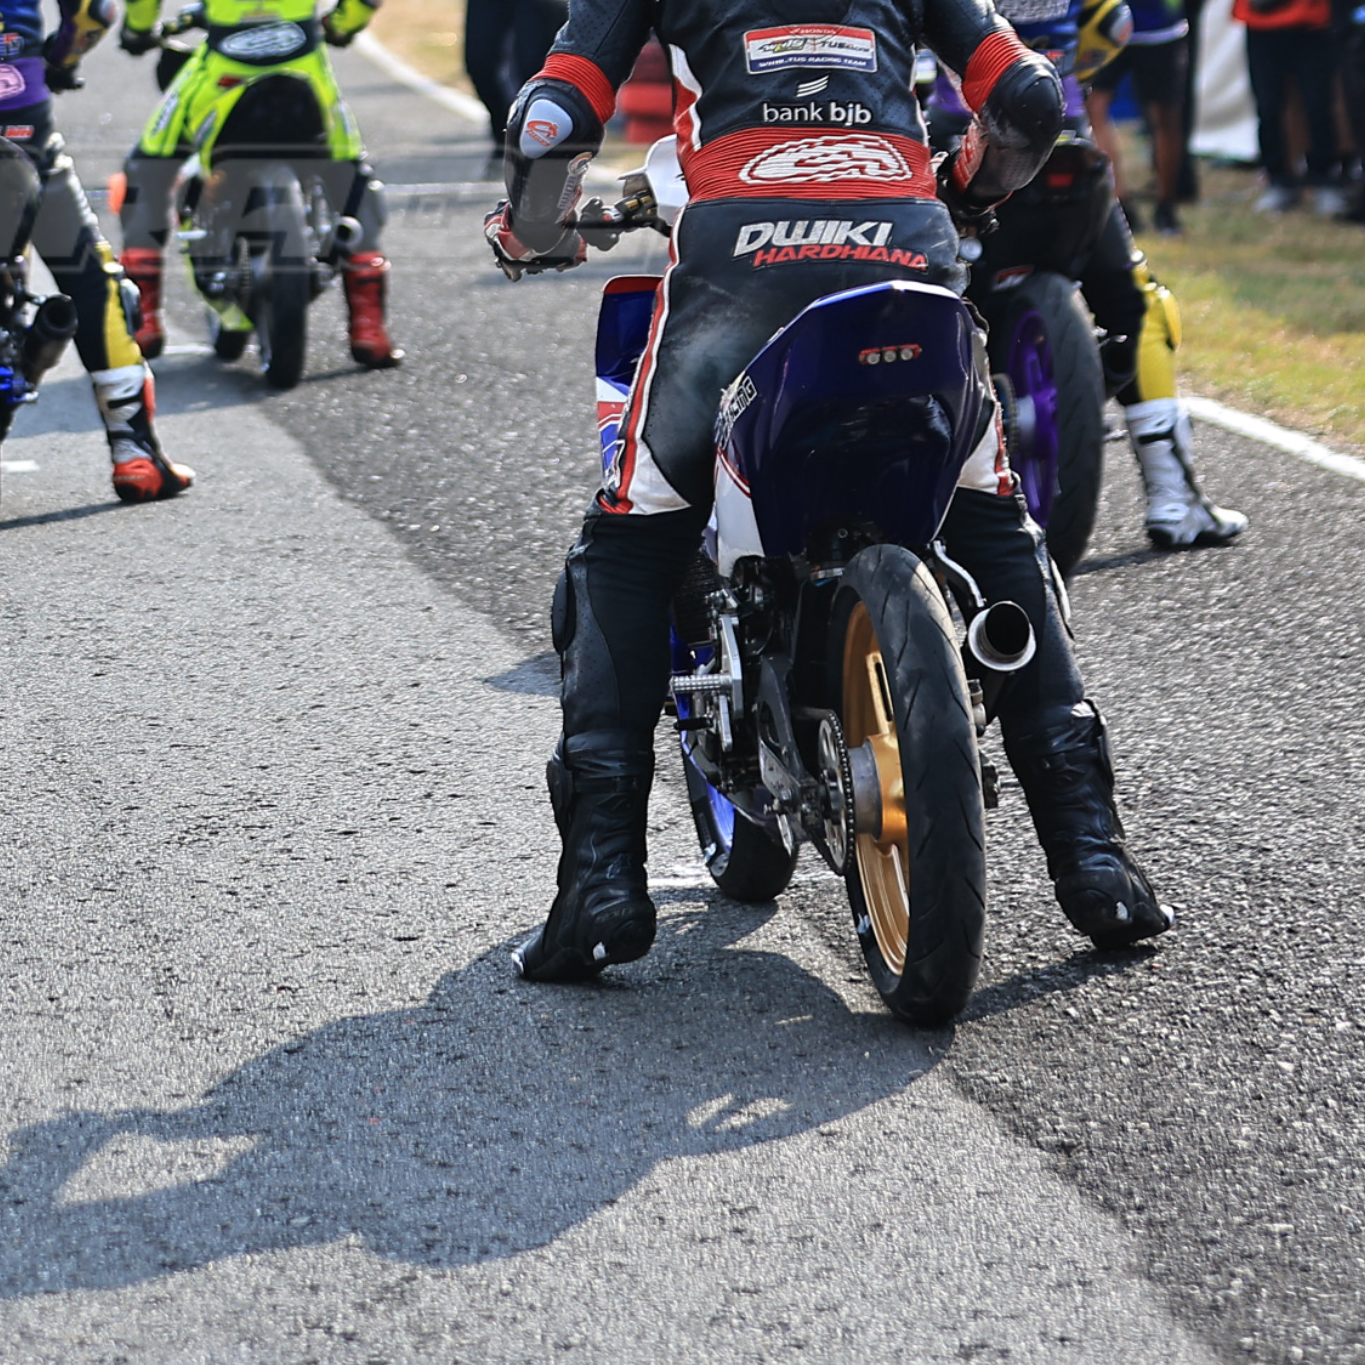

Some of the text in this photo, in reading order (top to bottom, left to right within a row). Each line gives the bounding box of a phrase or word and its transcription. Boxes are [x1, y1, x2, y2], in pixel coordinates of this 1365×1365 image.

[763, 102, 872, 126] bank bjb
[733, 220, 894, 258] DWIKI
[752, 243, 929, 271] HARDHIANA
